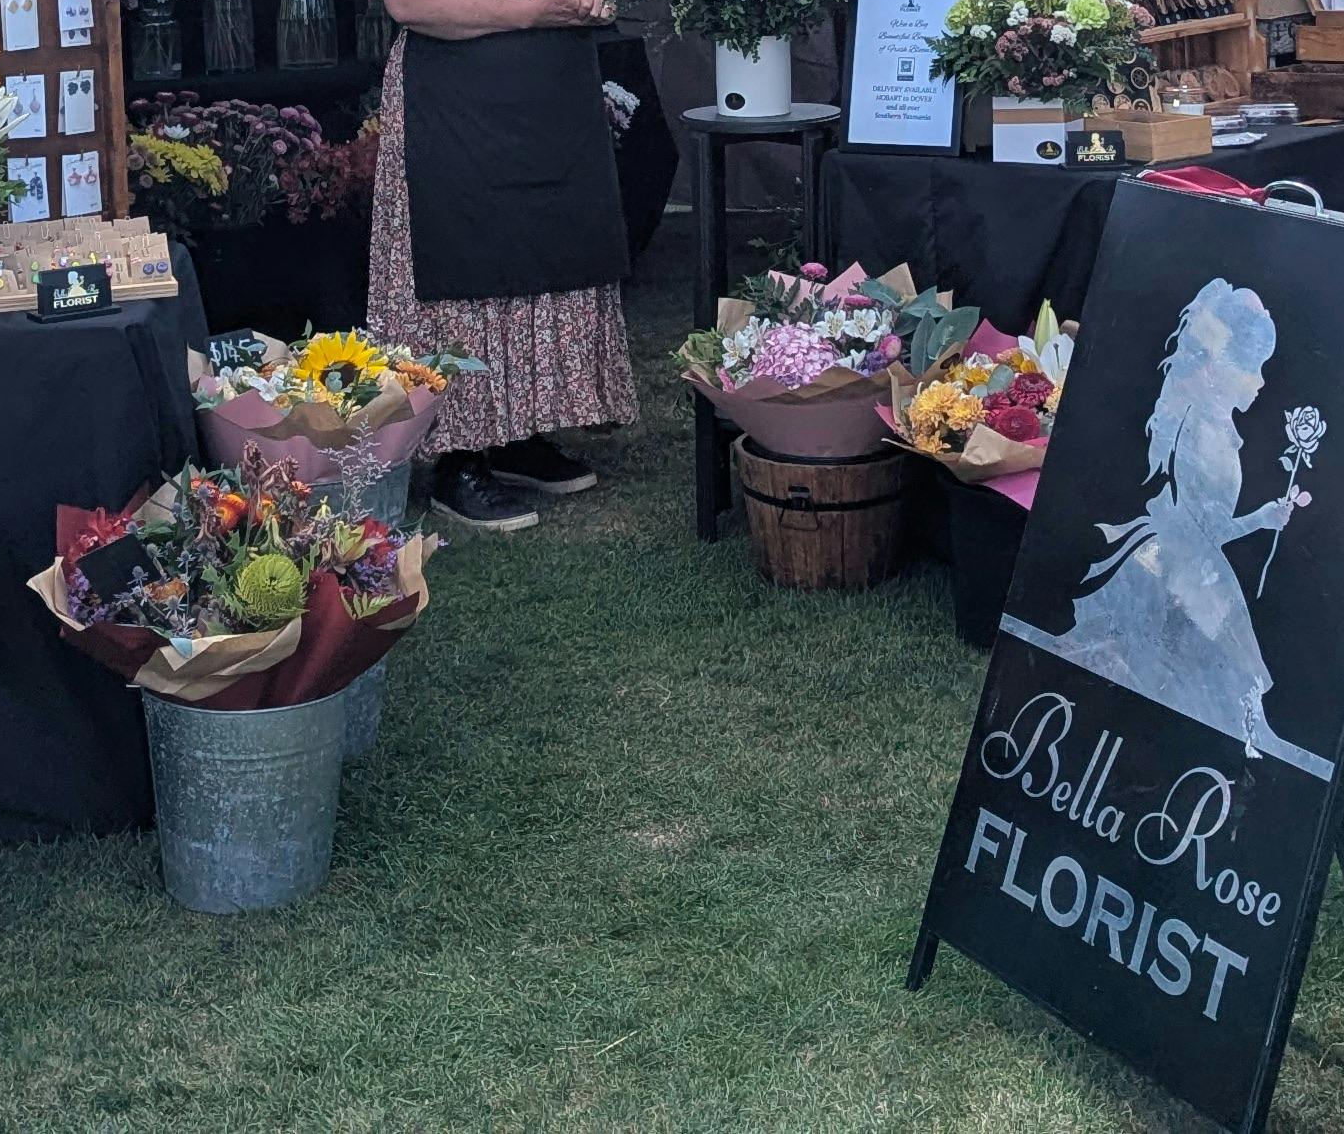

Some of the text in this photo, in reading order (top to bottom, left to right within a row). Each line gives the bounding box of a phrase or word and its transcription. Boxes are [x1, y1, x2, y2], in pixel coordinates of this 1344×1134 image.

[872, 85, 903, 93] DELIVERY
[875, 94, 902, 102] HOBART
[910, 95, 933, 103] DOVER
[53, 295, 99, 309] FLORIST
[980, 692, 1282, 927] Bella Rose
[963, 806, 1250, 1022] FLORIST
